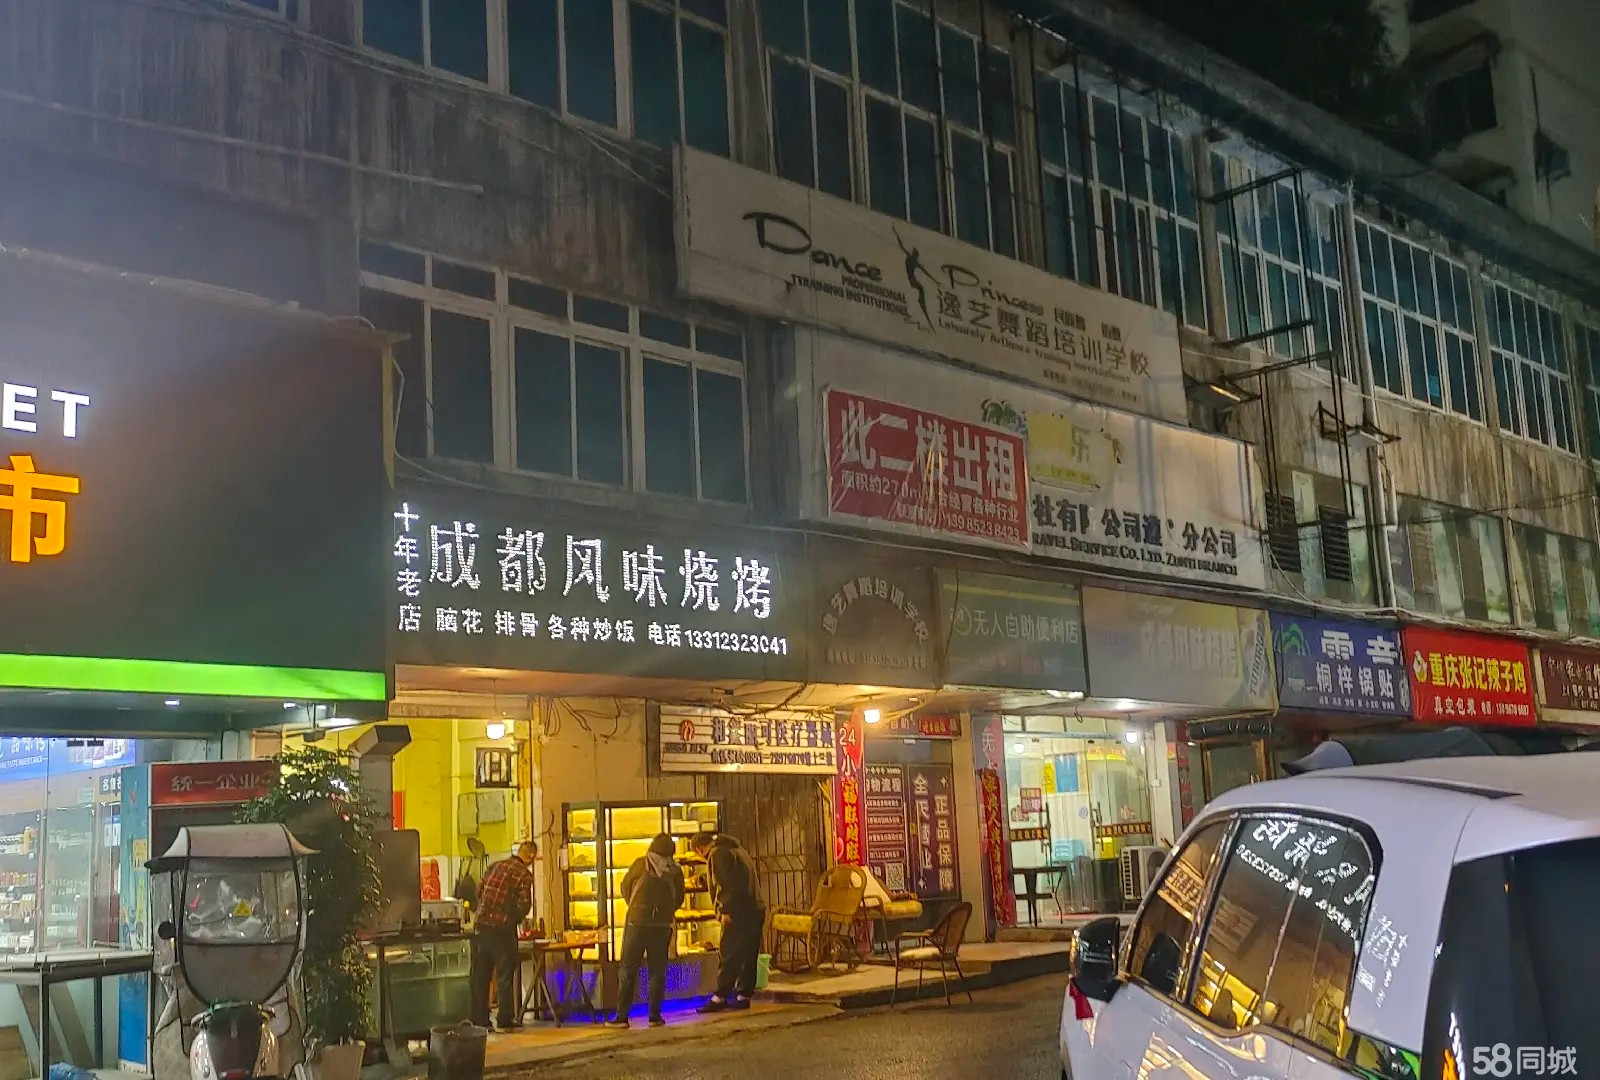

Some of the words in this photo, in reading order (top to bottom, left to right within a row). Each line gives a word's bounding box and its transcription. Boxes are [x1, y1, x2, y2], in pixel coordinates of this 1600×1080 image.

[742, 212, 882, 282] Dance
[941, 264, 1044, 316] Princess
[937, 289, 1151, 379] 逸艺舞蹈培训学校
[2, 383, 90, 438] ET
[840, 399, 1018, 502] 此二楼出租
[0, 455, 80, 563] 市
[1033, 494, 1238, 559] 社有公司遵分公司
[393, 502, 422, 632] 十年老店
[429, 520, 771, 619] 成都风味烧烤
[495, 609, 540, 639] 排骨
[548, 613, 635, 644] 各种炒饭
[973, 609, 1078, 645] 无人自助便利店
[1316, 661, 1395, 699] 桐梓锅贴
[1429, 652, 1527, 695] 重庆张记辣子鸡
[933, 793, 954, 892] 正品保障
